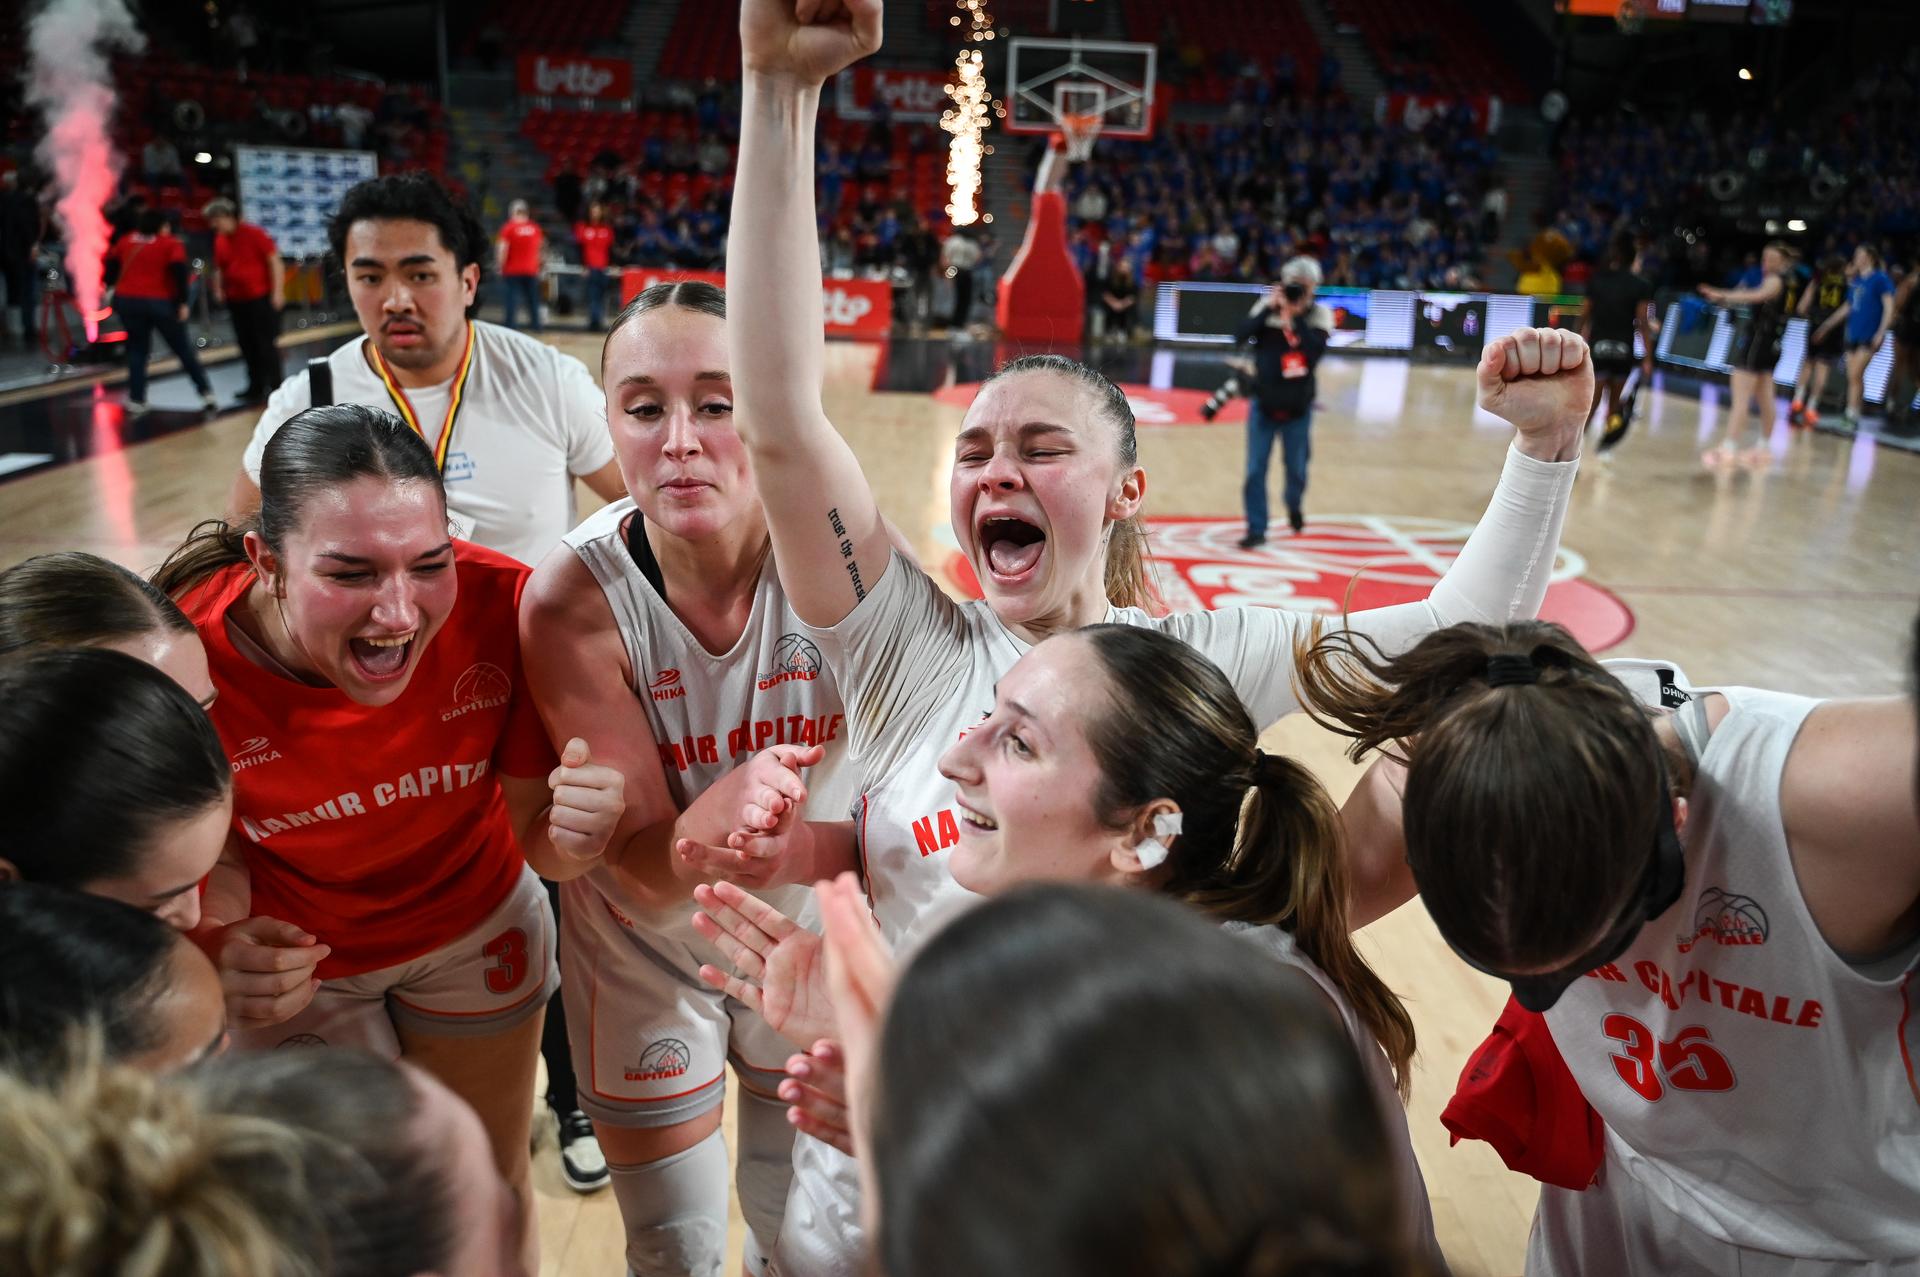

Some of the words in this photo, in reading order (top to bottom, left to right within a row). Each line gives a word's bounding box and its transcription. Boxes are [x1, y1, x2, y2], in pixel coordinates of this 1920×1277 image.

[827, 508, 846, 539] trust
[840, 539, 853, 559] the
[650, 685, 687, 701] HIKA
[758, 670, 818, 691] CAPITALE
[441, 695, 508, 722] CAPITALE
[232, 750, 282, 773] DHIKA
[373, 759, 489, 808] CAPITA
[482, 926, 529, 994] 3
[1601, 1012, 1737, 1103] 35
[624, 1066, 685, 1081] CAPITALE
